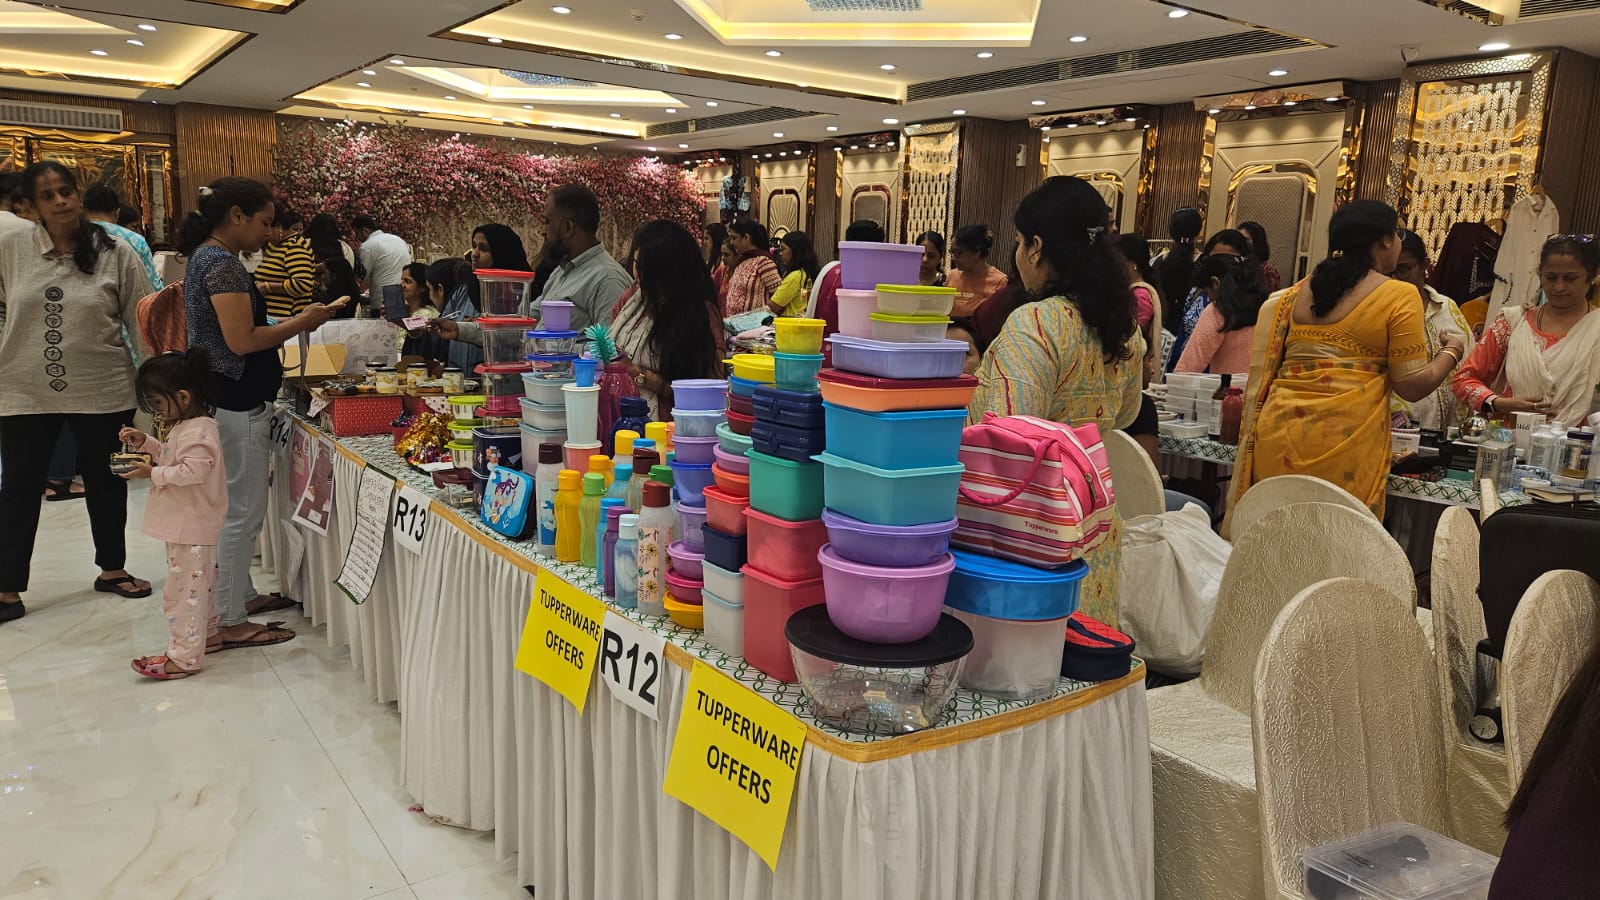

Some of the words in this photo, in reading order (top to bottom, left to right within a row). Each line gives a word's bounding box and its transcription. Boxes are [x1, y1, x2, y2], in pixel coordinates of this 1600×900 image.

[394, 496, 426, 542] R13
[540, 588, 601, 642] TUPPERWARE
[545, 630, 584, 670] OFFERS
[600, 628, 659, 706] R12
[697, 689, 798, 770] TUPPERWARE
[706, 745, 772, 804] OFFERS
